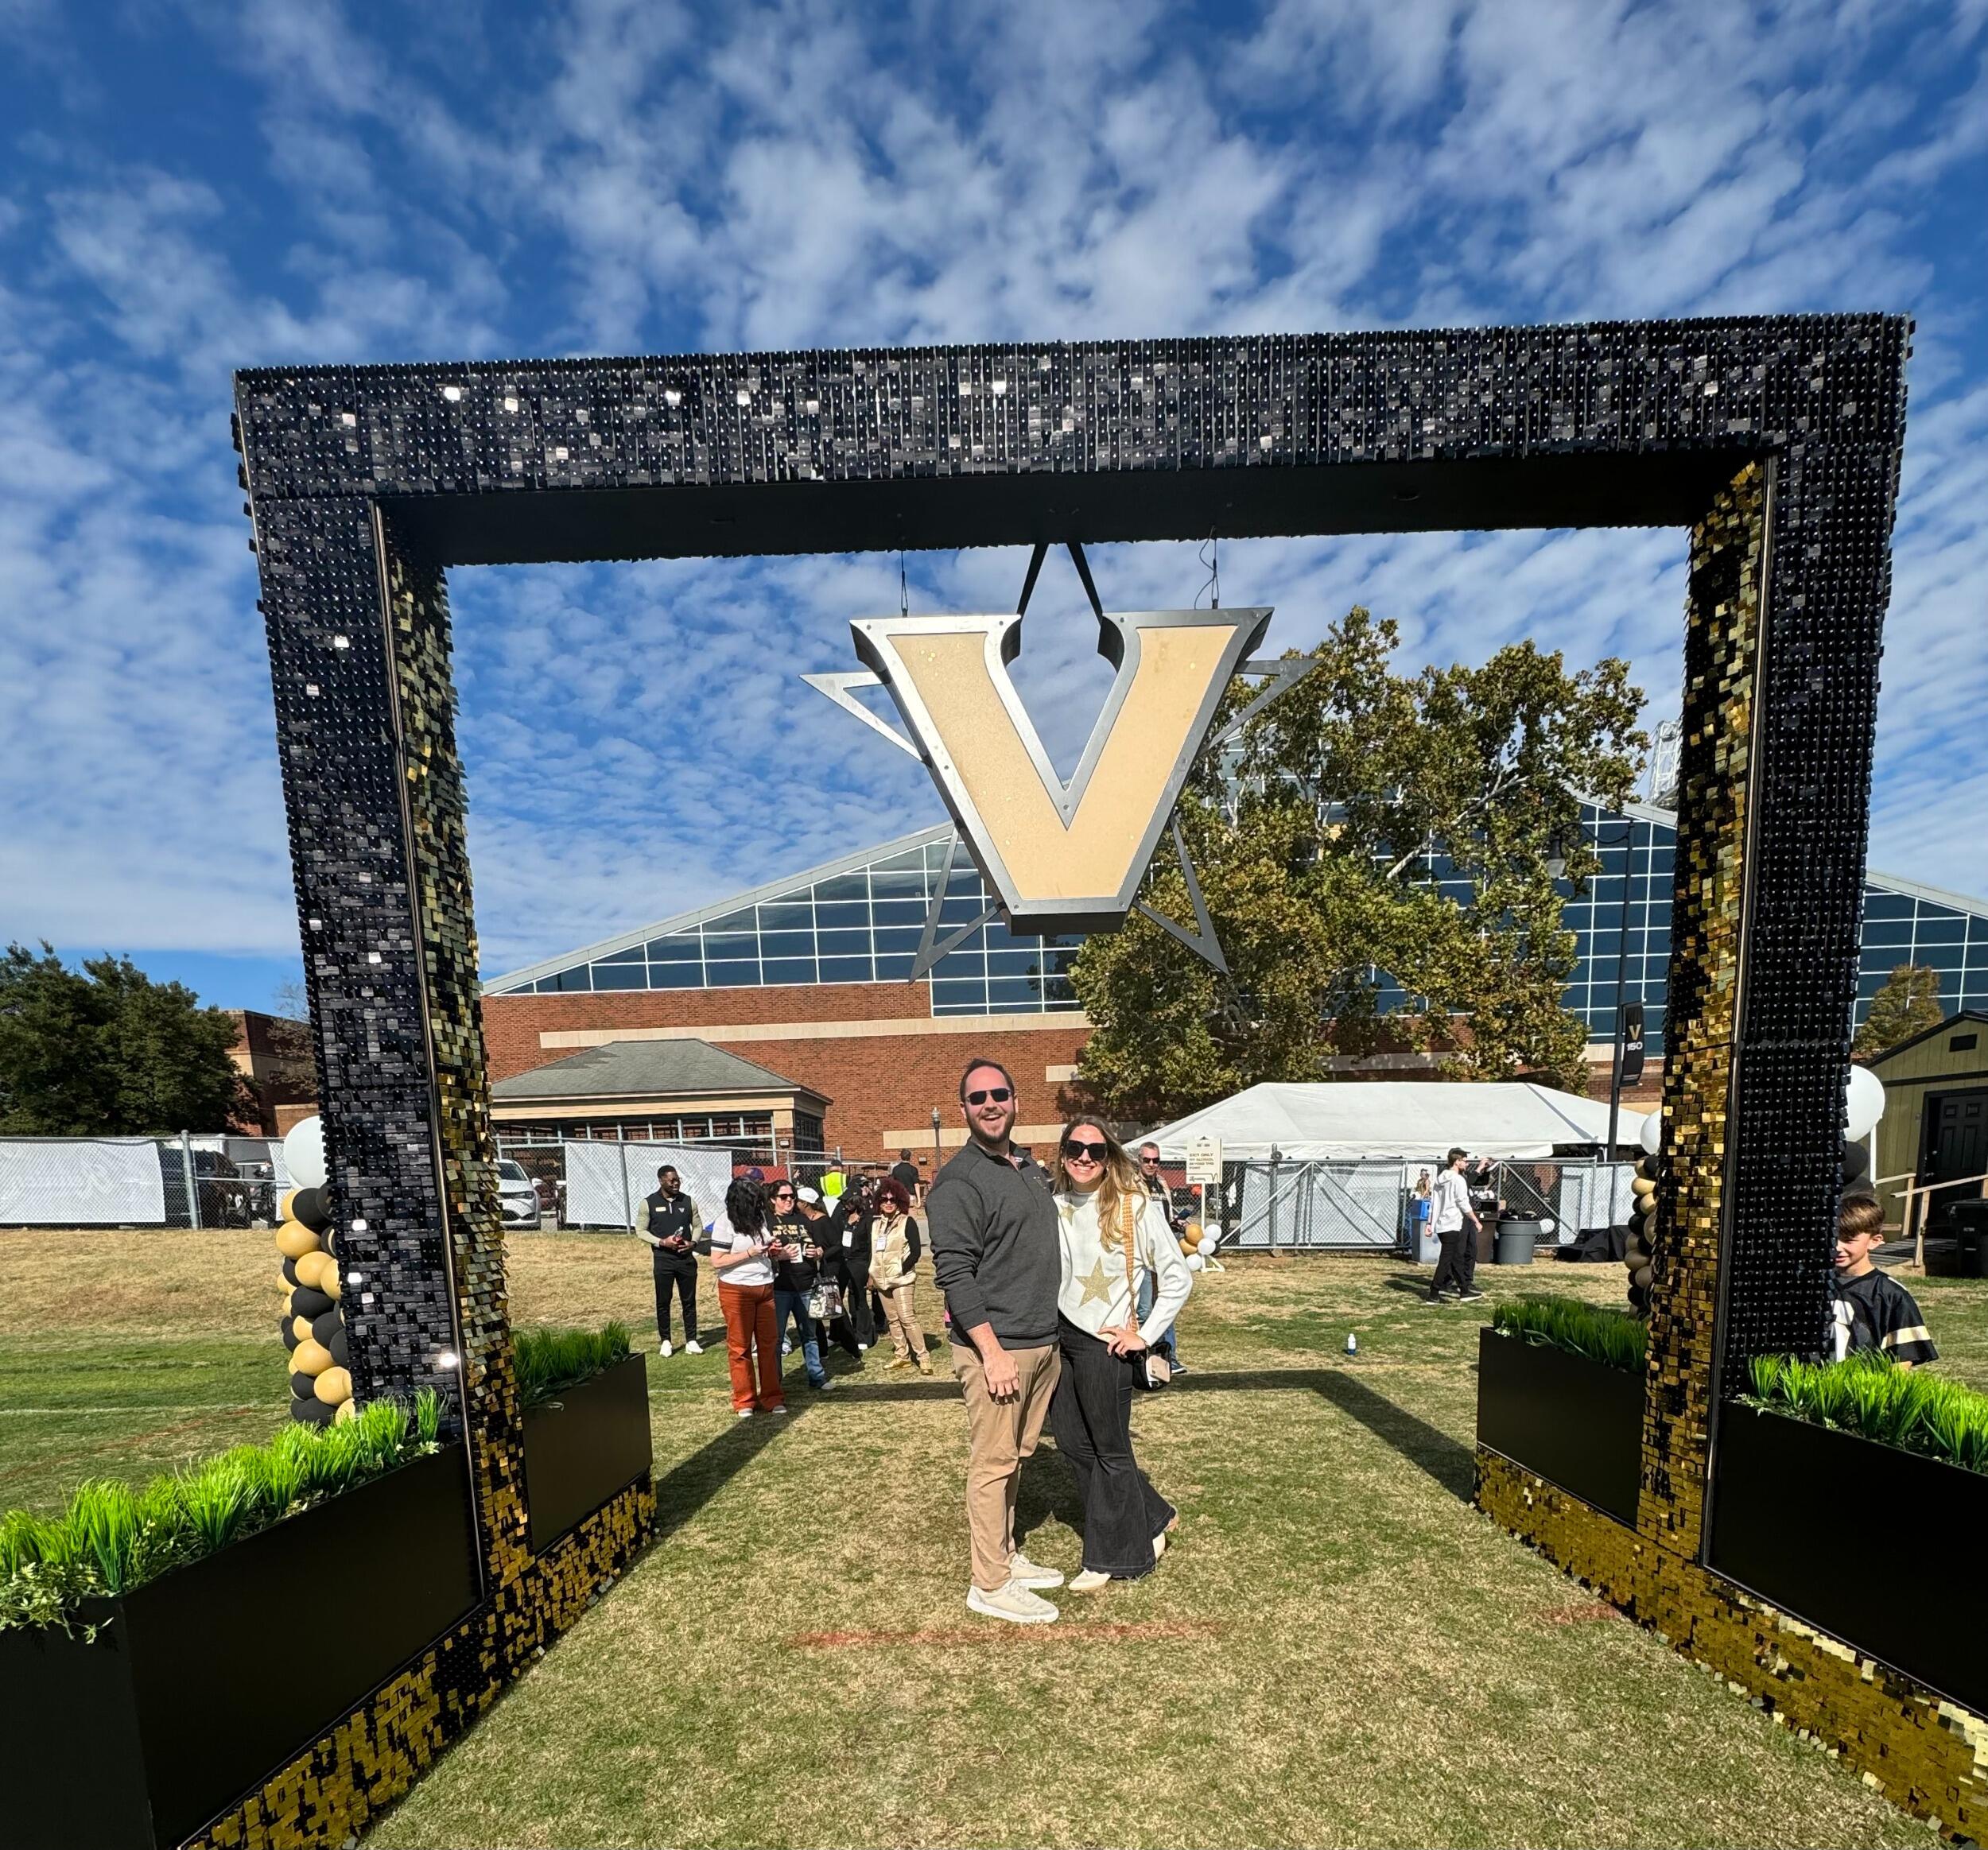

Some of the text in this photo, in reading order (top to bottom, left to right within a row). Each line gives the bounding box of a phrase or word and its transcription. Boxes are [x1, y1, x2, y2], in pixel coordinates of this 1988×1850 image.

[848, 607, 1275, 916] V
[1629, 1024, 1641, 1041] V
[1627, 1041, 1643, 1051] 150
